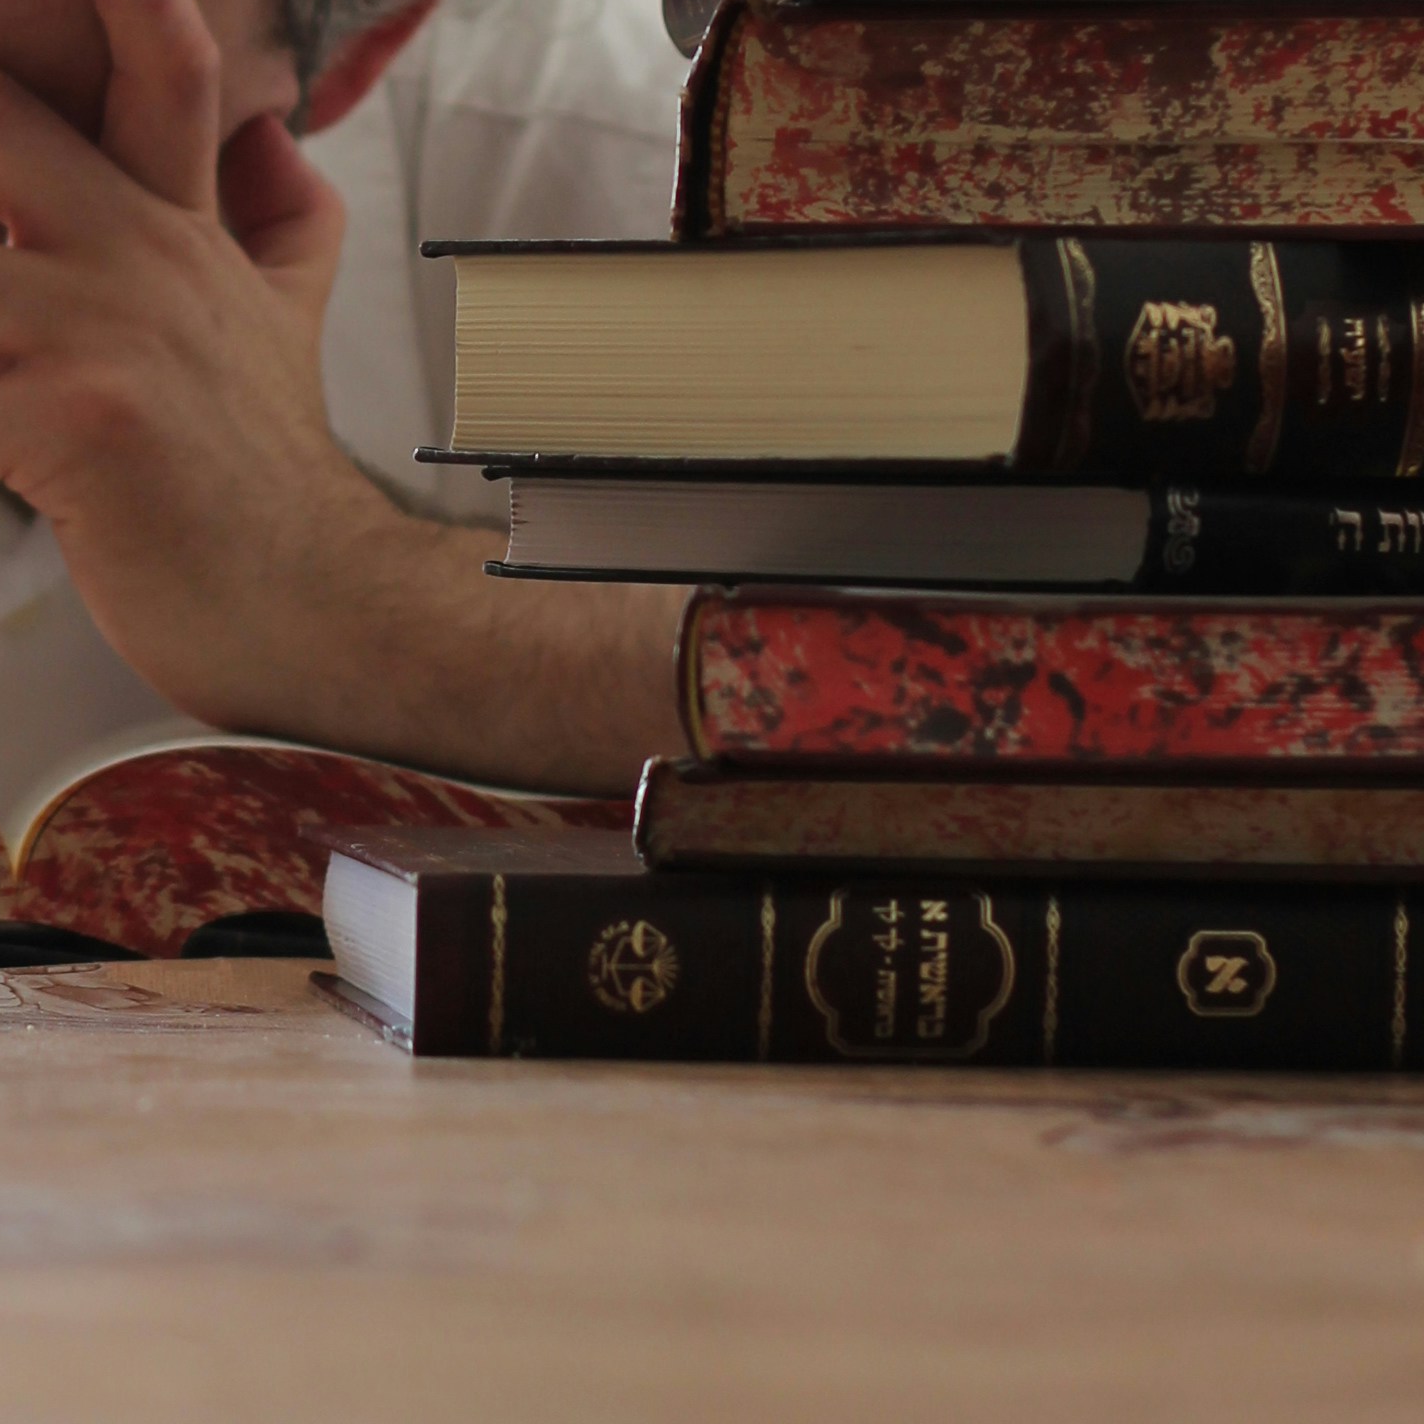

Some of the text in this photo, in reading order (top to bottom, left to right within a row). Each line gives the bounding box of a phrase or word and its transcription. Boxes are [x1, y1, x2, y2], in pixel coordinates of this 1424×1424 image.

[917, 899, 949, 1038] בראשית א
[1204, 955, 1250, 994] א
